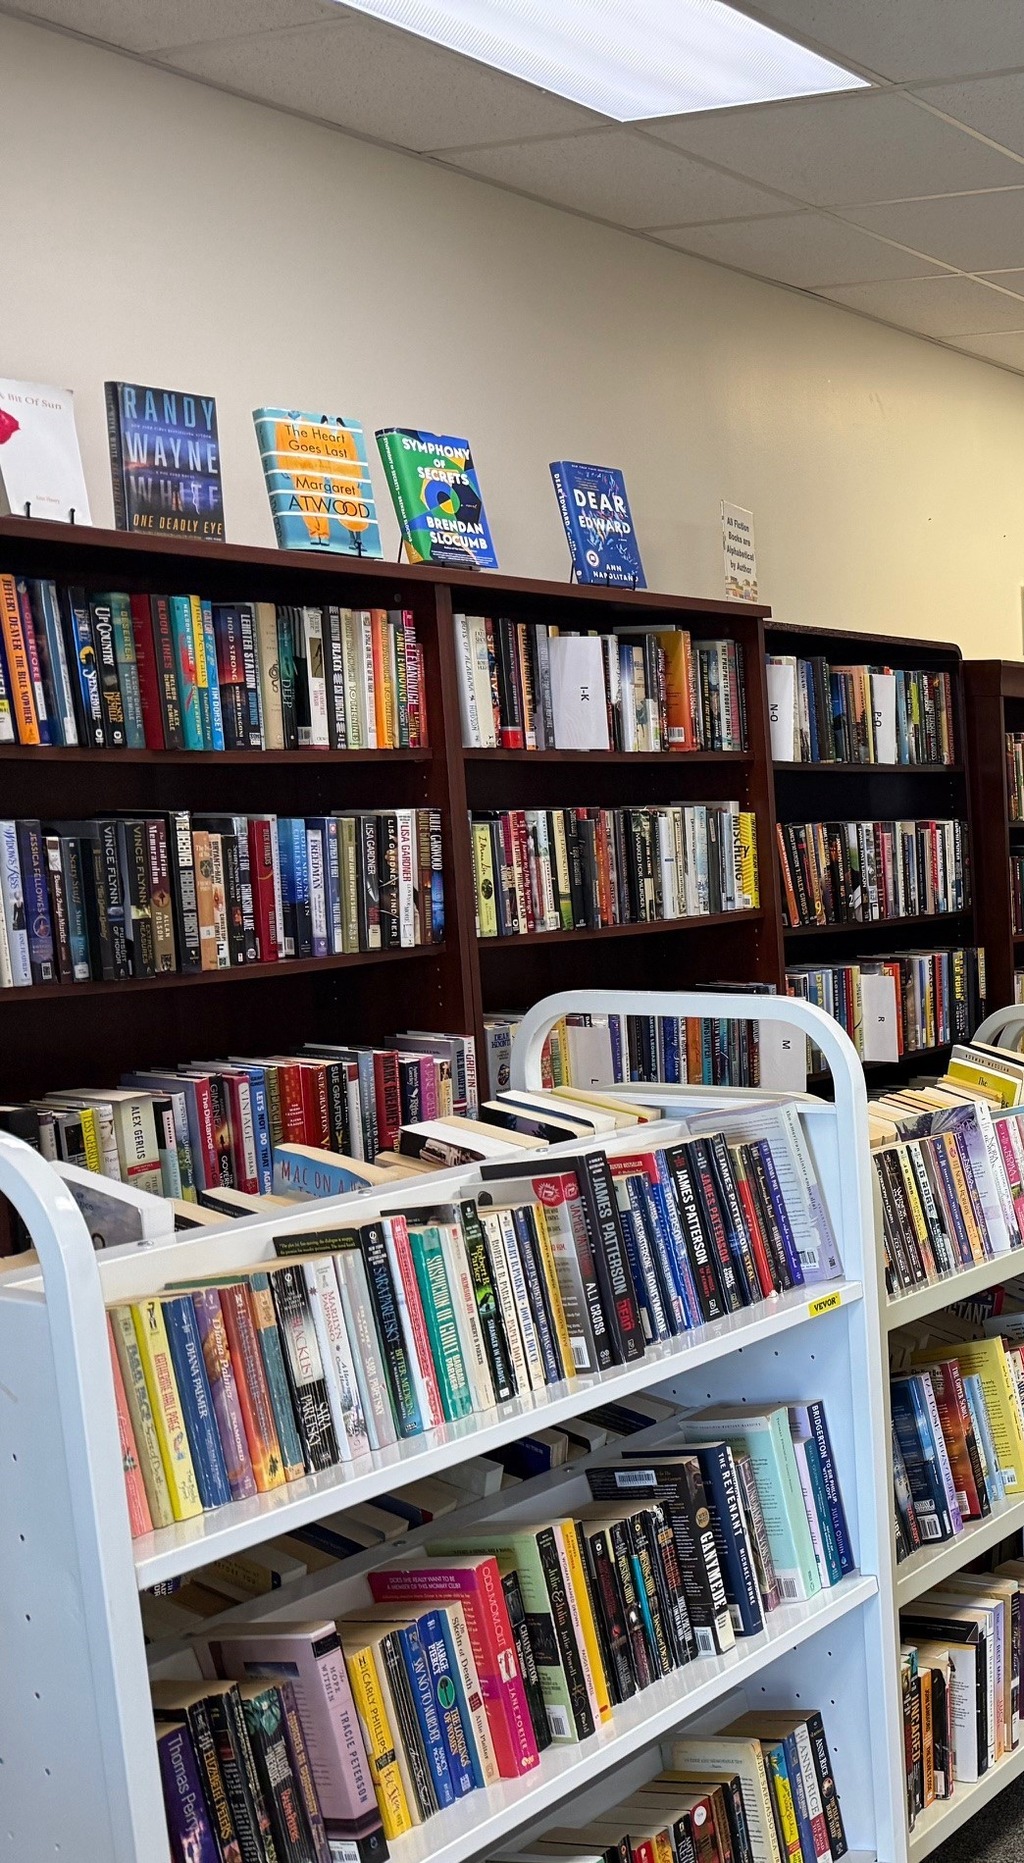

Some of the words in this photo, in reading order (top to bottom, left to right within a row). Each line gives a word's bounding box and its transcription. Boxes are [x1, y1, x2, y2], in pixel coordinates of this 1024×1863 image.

[25, 396, 38, 407] Of
[42, 400, 62, 410] Sun
[124, 387, 214, 431] RANDY
[285, 425, 307, 438] The
[313, 429, 345, 444] Heart
[289, 441, 321, 454] Goes
[325, 444, 347, 458] Last
[402, 438, 470, 460] SYMPHONY
[125, 432, 218, 474] WAYNE
[433, 459, 445, 468] OF
[296, 476, 356, 497] Margaret
[417, 466, 469, 486] SECRETS
[554, 473, 563, 495] DEAR
[289, 495, 370, 519] ATWOOD
[573, 489, 626, 513] DEAR
[134, 513, 153, 528] ONE
[159, 516, 198, 533] DEADLY
[203, 521, 223, 535] EYE
[427, 516, 484, 535] BRENDAN
[578, 515, 631, 535] EDWARD
[728, 531, 742, 543] Books
[734, 520, 749, 532] Fiction
[430, 531, 487, 550] SLOCUMB
[727, 545, 754, 561] Alphabetical
[593, 570, 639, 583] NAPOLITANO
[606, 563, 621, 572] ANN
[730, 560, 736, 571] by
[737, 562, 751, 574] Author
[95, 607, 110, 621] UP
[157, 600, 169, 634] BLOOD
[9, 616, 22, 651] DEAVER
[96, 622, 114, 666] COUNTRY
[162, 638, 172, 669] LINES
[229, 645, 238, 681] STRONG
[243, 652, 256, 689] STATION
[406, 653, 419, 705] EVANOVICH
[580, 686, 590, 702] I-K
[213, 702, 222, 732] DORSEY
[770, 703, 779, 722] N-O
[874, 711, 882, 728] P-Q
[30, 832, 39, 866] JESSICA
[104, 826, 115, 864] VINCE
[133, 827, 143, 863] VINCE
[400, 824, 410, 843] LISA
[732, 815, 743, 881] MISCHLING
[367, 842, 376, 875] GARDNER
[402, 845, 411, 882] GARDNER
[33, 868, 45, 913] FELLOWES
[107, 866, 118, 905] FLYNN
[137, 867, 146, 903] FLYNN
[241, 884, 254, 913] CRIMSON
[782, 1040, 790, 1050] M
[331, 1066, 339, 1085] SUE
[465, 1054, 476, 1088] GRIFFIN
[978, 1076, 988, 1087] The
[131, 1106, 142, 1126] ALEX
[332, 1086, 343, 1130] GRAFTON
[134, 1129, 146, 1161] GERLIS
[203, 1109, 213, 1150] Distance
[260, 1133, 266, 1145] DO
[260, 1147, 270, 1167] THAT
[263, 1171, 272, 1195] AGAIN
[281, 1160, 308, 1186] MAC
[315, 1174, 332, 1192] ON
[676, 1170, 694, 1203] JAMES
[685, 1204, 708, 1265] PATTERSON
[701, 1174, 716, 1206] JAMES
[709, 1207, 729, 1264] PATTERSON
[719, 1157, 733, 1192] JAMES
[728, 1193, 749, 1253] PATTERSON
[744, 1252, 755, 1284] STEAL
[592, 1174, 612, 1219] JAMES
[602, 1222, 628, 1296] PATTERSON
[426, 1255, 450, 1308] SUSPICION
[585, 1282, 598, 1302] ALI
[321, 1293, 335, 1342] PAPPANO
[326, 1291, 342, 1340] MARILYN
[646, 1272, 667, 1334] HONEYMOON
[813, 1299, 836, 1312] VEVOR
[590, 1303, 606, 1336] CROSS
[212, 1318, 224, 1361] Diana
[219, 1359, 234, 1401] Palmer
[185, 1342, 199, 1378] DIANA
[192, 1378, 208, 1420] PALMER
[812, 1405, 827, 1458] BRIDGERTON
[718, 1453, 727, 1469] THE
[722, 1470, 743, 1536] REVENANT
[482, 1566, 494, 1593] ODD
[700, 1531, 727, 1610] GANYMEDE
[428, 1643, 441, 1675] PIERCY
[434, 1639, 449, 1672] MARGE
[451, 1617, 462, 1650] Skein
[461, 1658, 473, 1690] Death
[320, 1664, 336, 1704] WITHIN
[330, 1666, 342, 1695] HOPE
[363, 1674, 376, 1709] CARLY
[371, 1708, 387, 1754] PHILLIPS
[339, 1710, 356, 1750] TRACIE
[350, 1751, 369, 1805] PETERSON
[755, 1753, 765, 1781] WIDE
[168, 1733, 189, 1794] Thomas
[181, 1792, 199, 1832] Perry
[799, 1746, 813, 1783] ANNE
[807, 1783, 819, 1815] RICE
